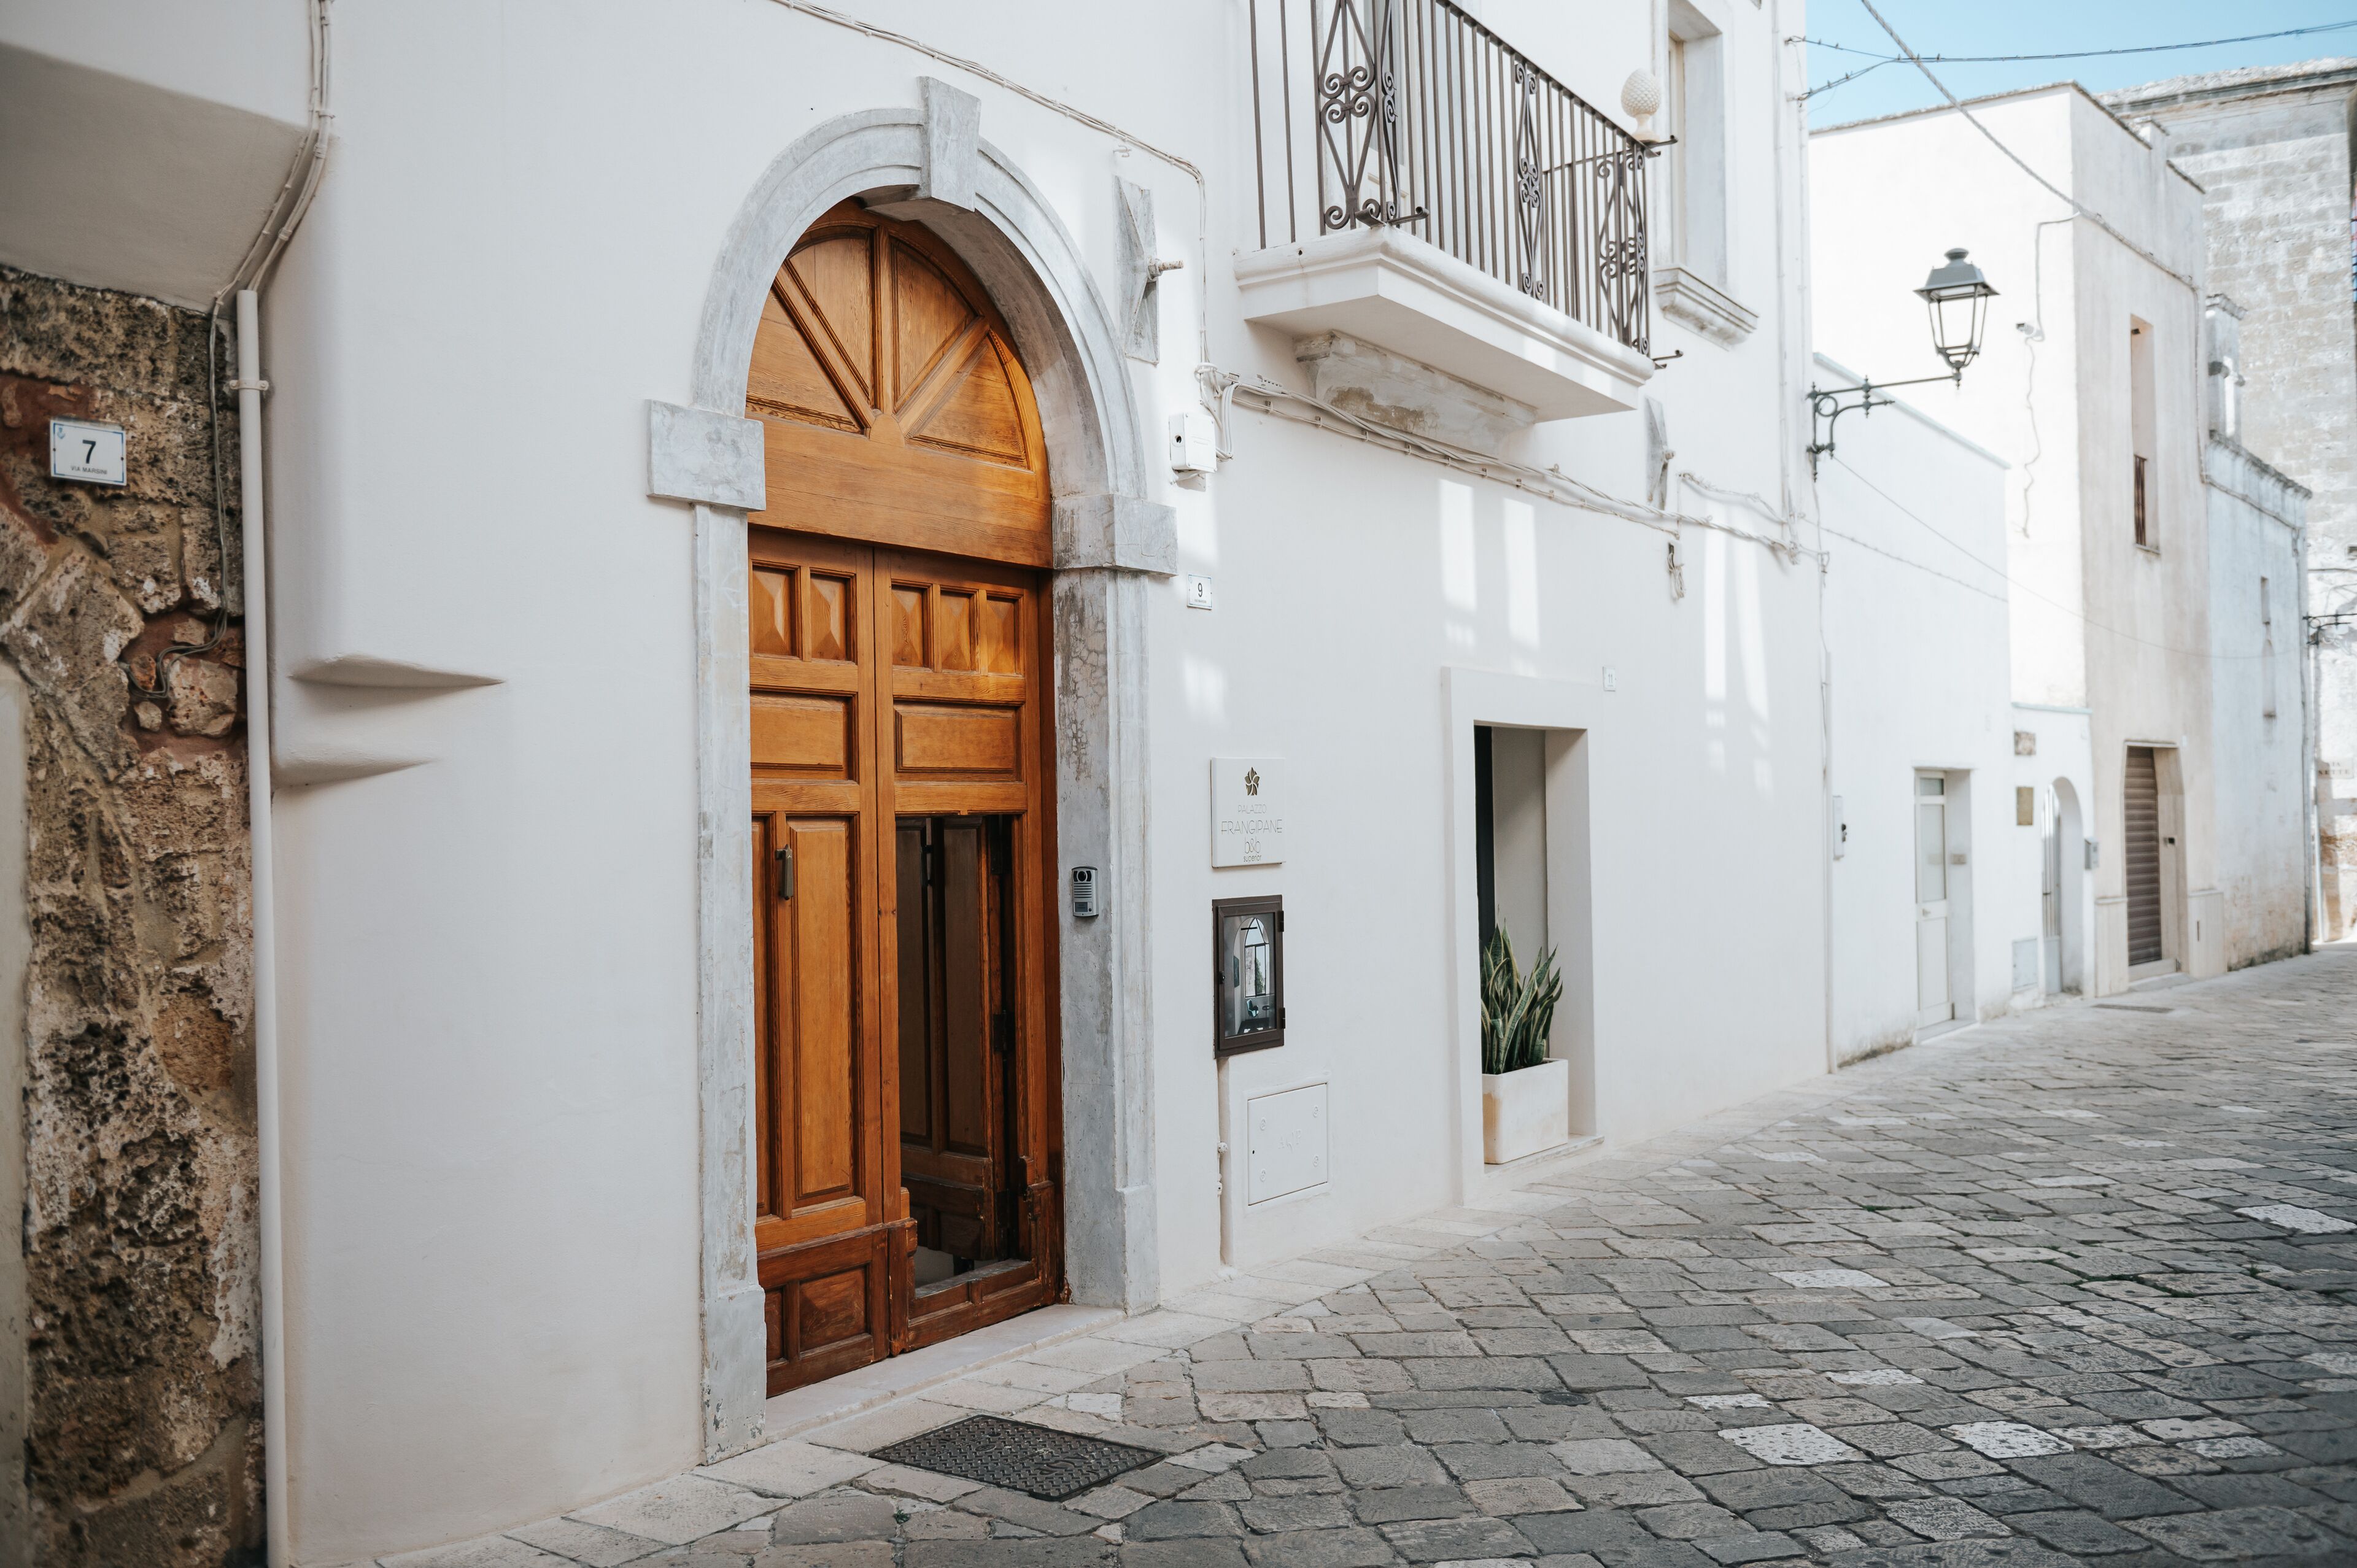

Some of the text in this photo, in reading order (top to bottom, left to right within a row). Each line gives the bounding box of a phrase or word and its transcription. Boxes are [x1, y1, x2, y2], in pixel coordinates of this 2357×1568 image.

[82, 439, 96, 464] 7
[1198, 583, 1202, 597] 9
[1237, 805, 1267, 814] PALAZZO
[1221, 819, 1282, 835] FRANGIPANE
[1245, 835, 1261, 854] b&b
